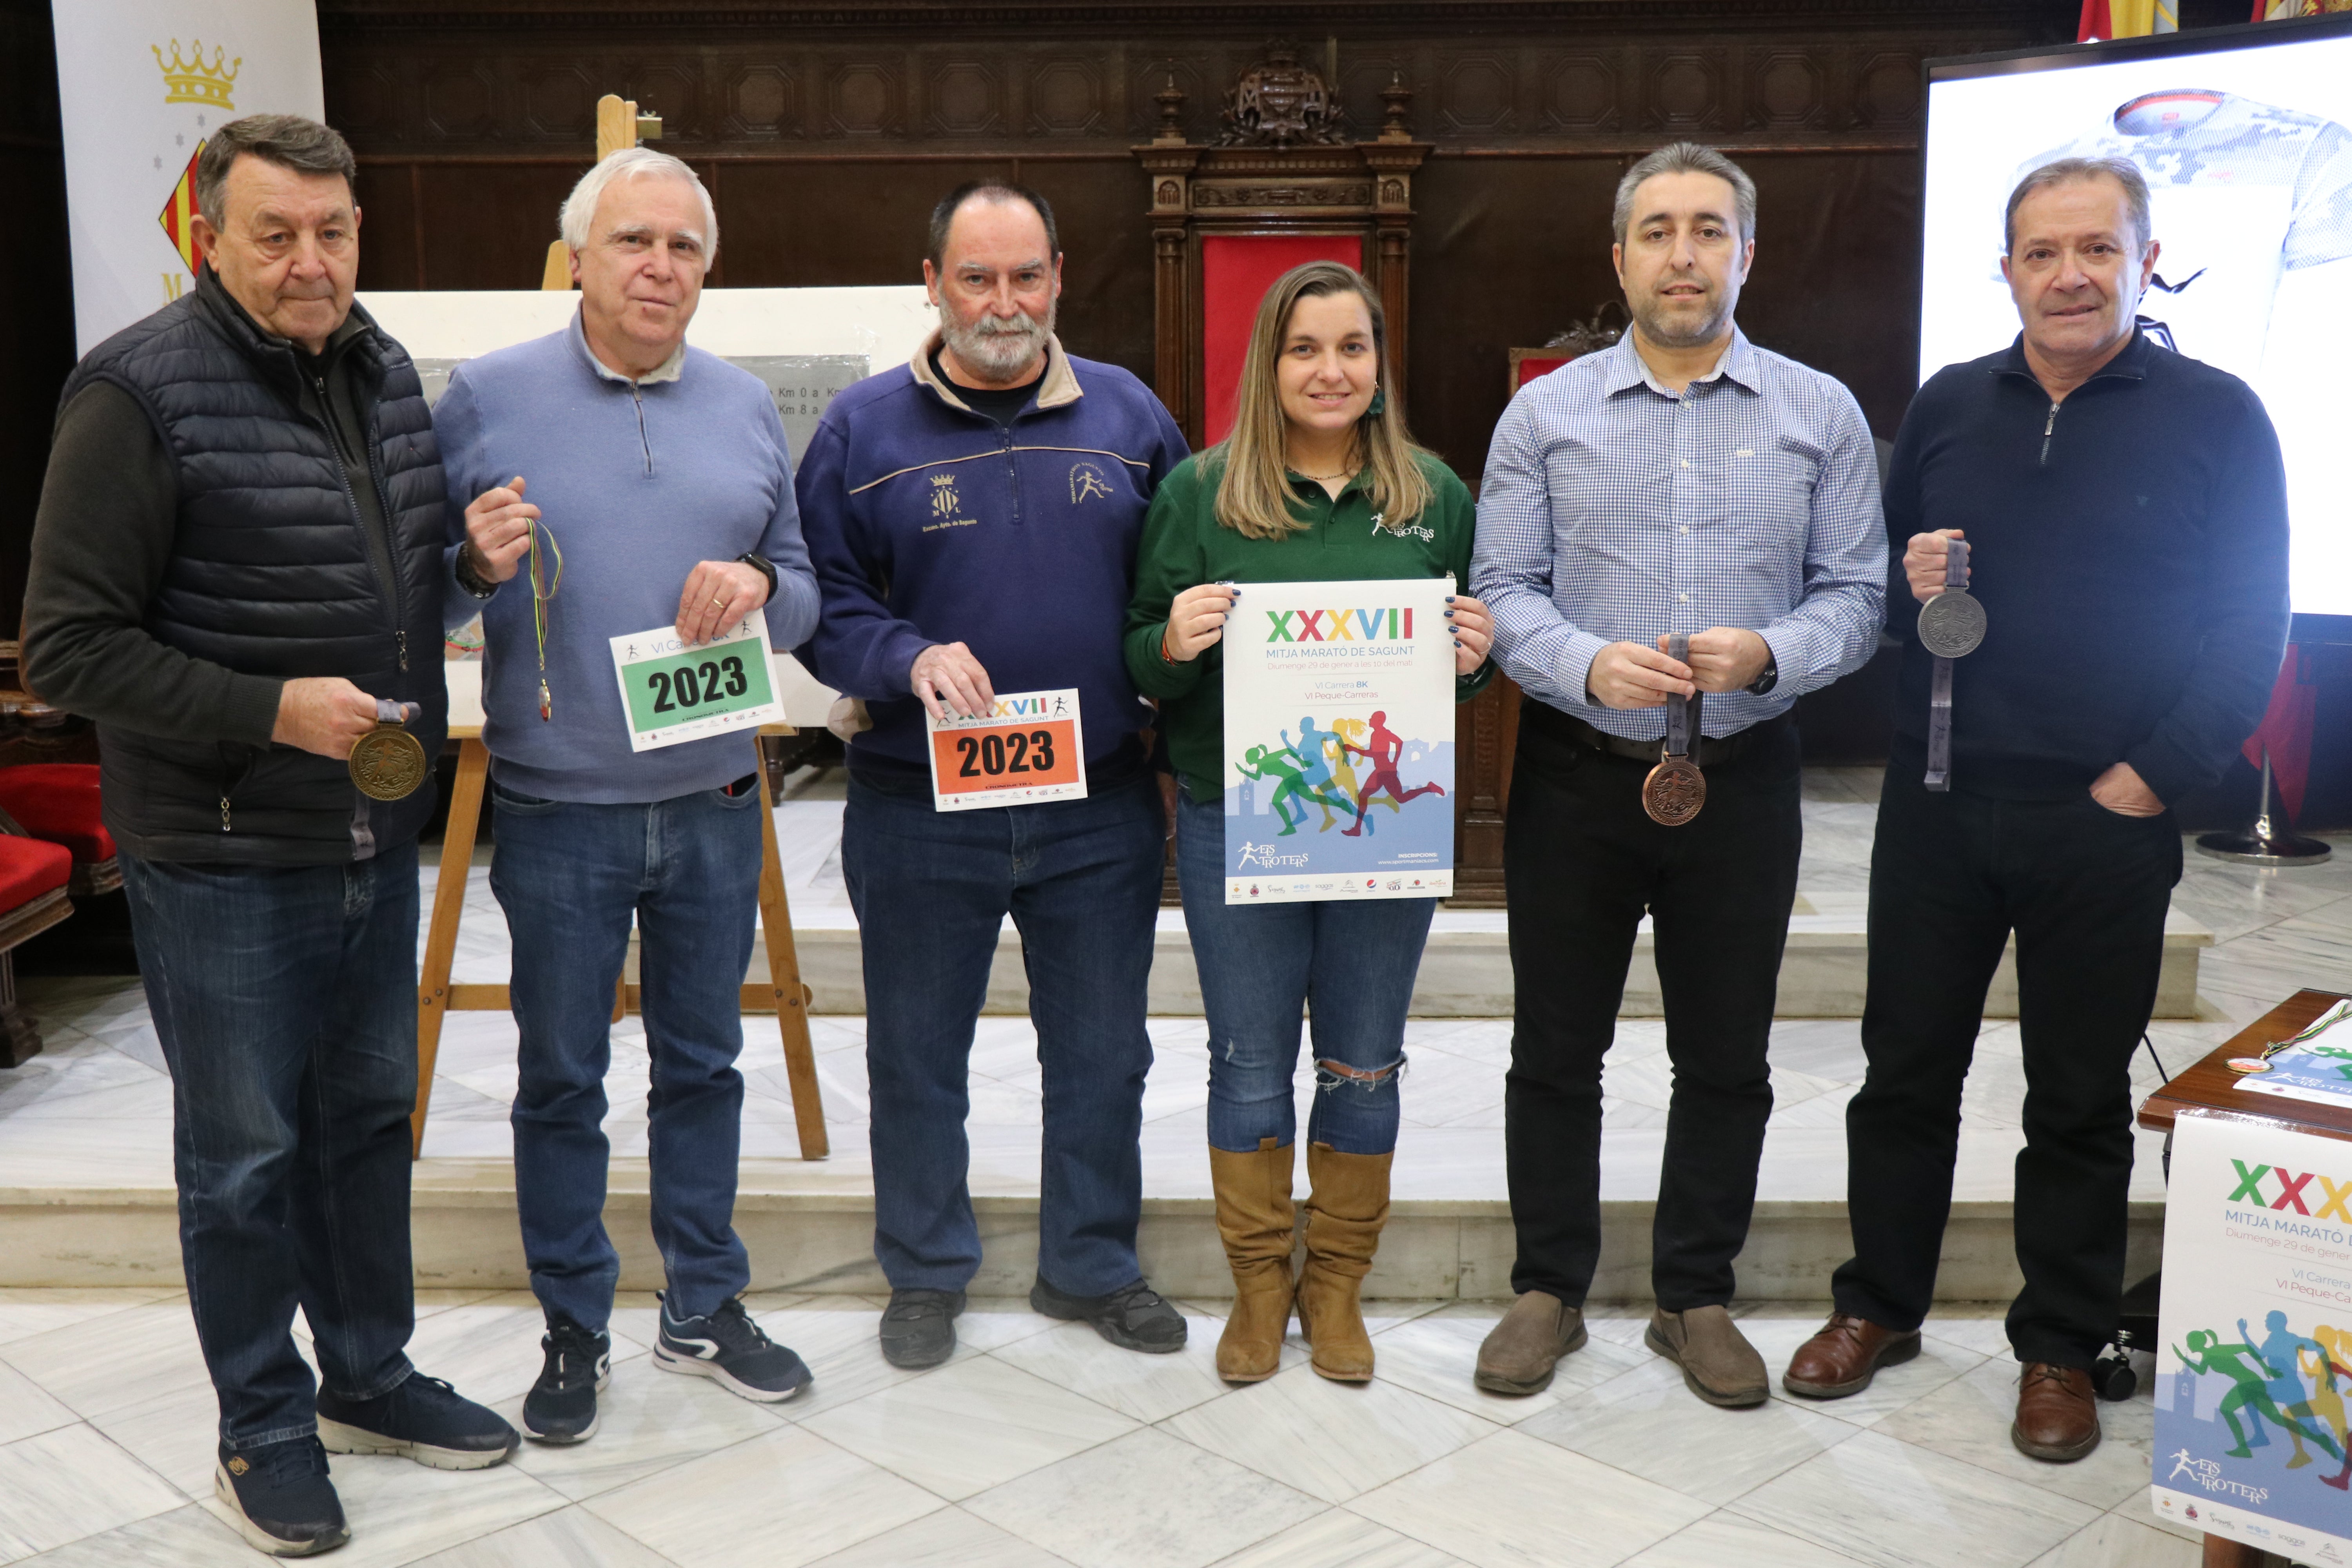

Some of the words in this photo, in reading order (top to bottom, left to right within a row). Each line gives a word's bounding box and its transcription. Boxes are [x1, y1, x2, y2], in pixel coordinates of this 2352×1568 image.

[161, 273, 183, 307] M
[779, 388, 795, 397] Km
[801, 387, 807, 397] 0
[779, 405, 795, 414] Km
[801, 405, 807, 415] 8
[1392, 526, 1434, 542] TROTERS
[1265, 608, 1412, 642] XXXVII
[652, 642, 664, 653] VI
[1267, 649, 1298, 658] MITJA
[1301, 646, 1347, 657] MARATÓ
[1351, 647, 1365, 656] DE
[1368, 646, 1415, 655] SAGUNT
[1268, 662, 1306, 671] Diumenge
[648, 656, 748, 713] 2023
[1315, 691, 1378, 701] Peque-Carreras
[957, 730, 1054, 777] 2023
[1260, 844, 1275, 856] ELS
[1259, 853, 1308, 868] TROTERS
[2225, 1209, 2270, 1229] MITJA
[2274, 1220, 2343, 1243] MARATÓ
[2226, 1227, 2281, 1247] Diumenge
[2283, 1240, 2298, 1250] 29
[2301, 1244, 2315, 1253] de
[2318, 1248, 2350, 1261] gener
[2292, 1268, 2303, 1279] VI
[2306, 1272, 2350, 1289] Carrera
[2276, 1279, 2287, 1289] VI
[2291, 1282, 2352, 1303] Peque-Ca
[2200, 1458, 2220, 1476] ELS
[2197, 1473, 2268, 1504] TROTERS
